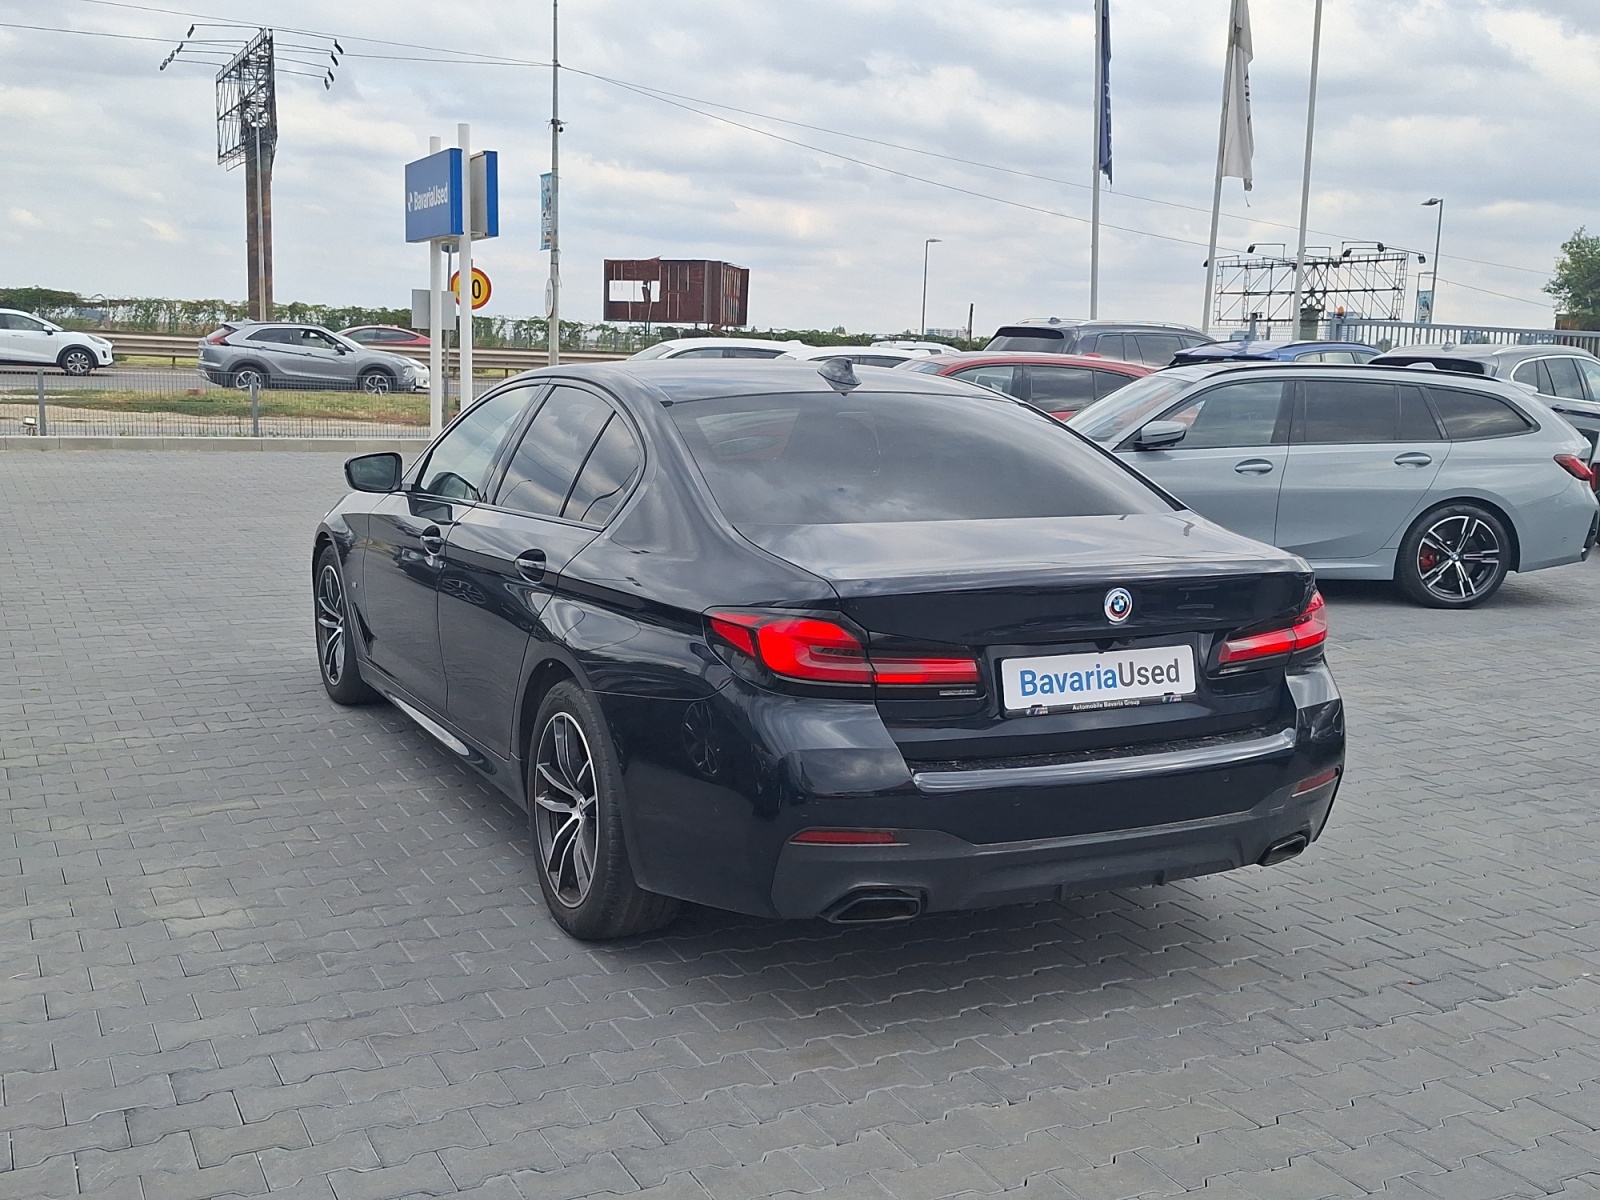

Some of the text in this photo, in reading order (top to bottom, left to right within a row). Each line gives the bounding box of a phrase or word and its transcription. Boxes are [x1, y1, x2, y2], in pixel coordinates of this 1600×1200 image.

[413, 182, 448, 211] BavariaUsed
[1019, 658, 1180, 696] BavariaUsed
[1072, 702, 1103, 711] Automobile
[1103, 700, 1123, 708] Bavaria
